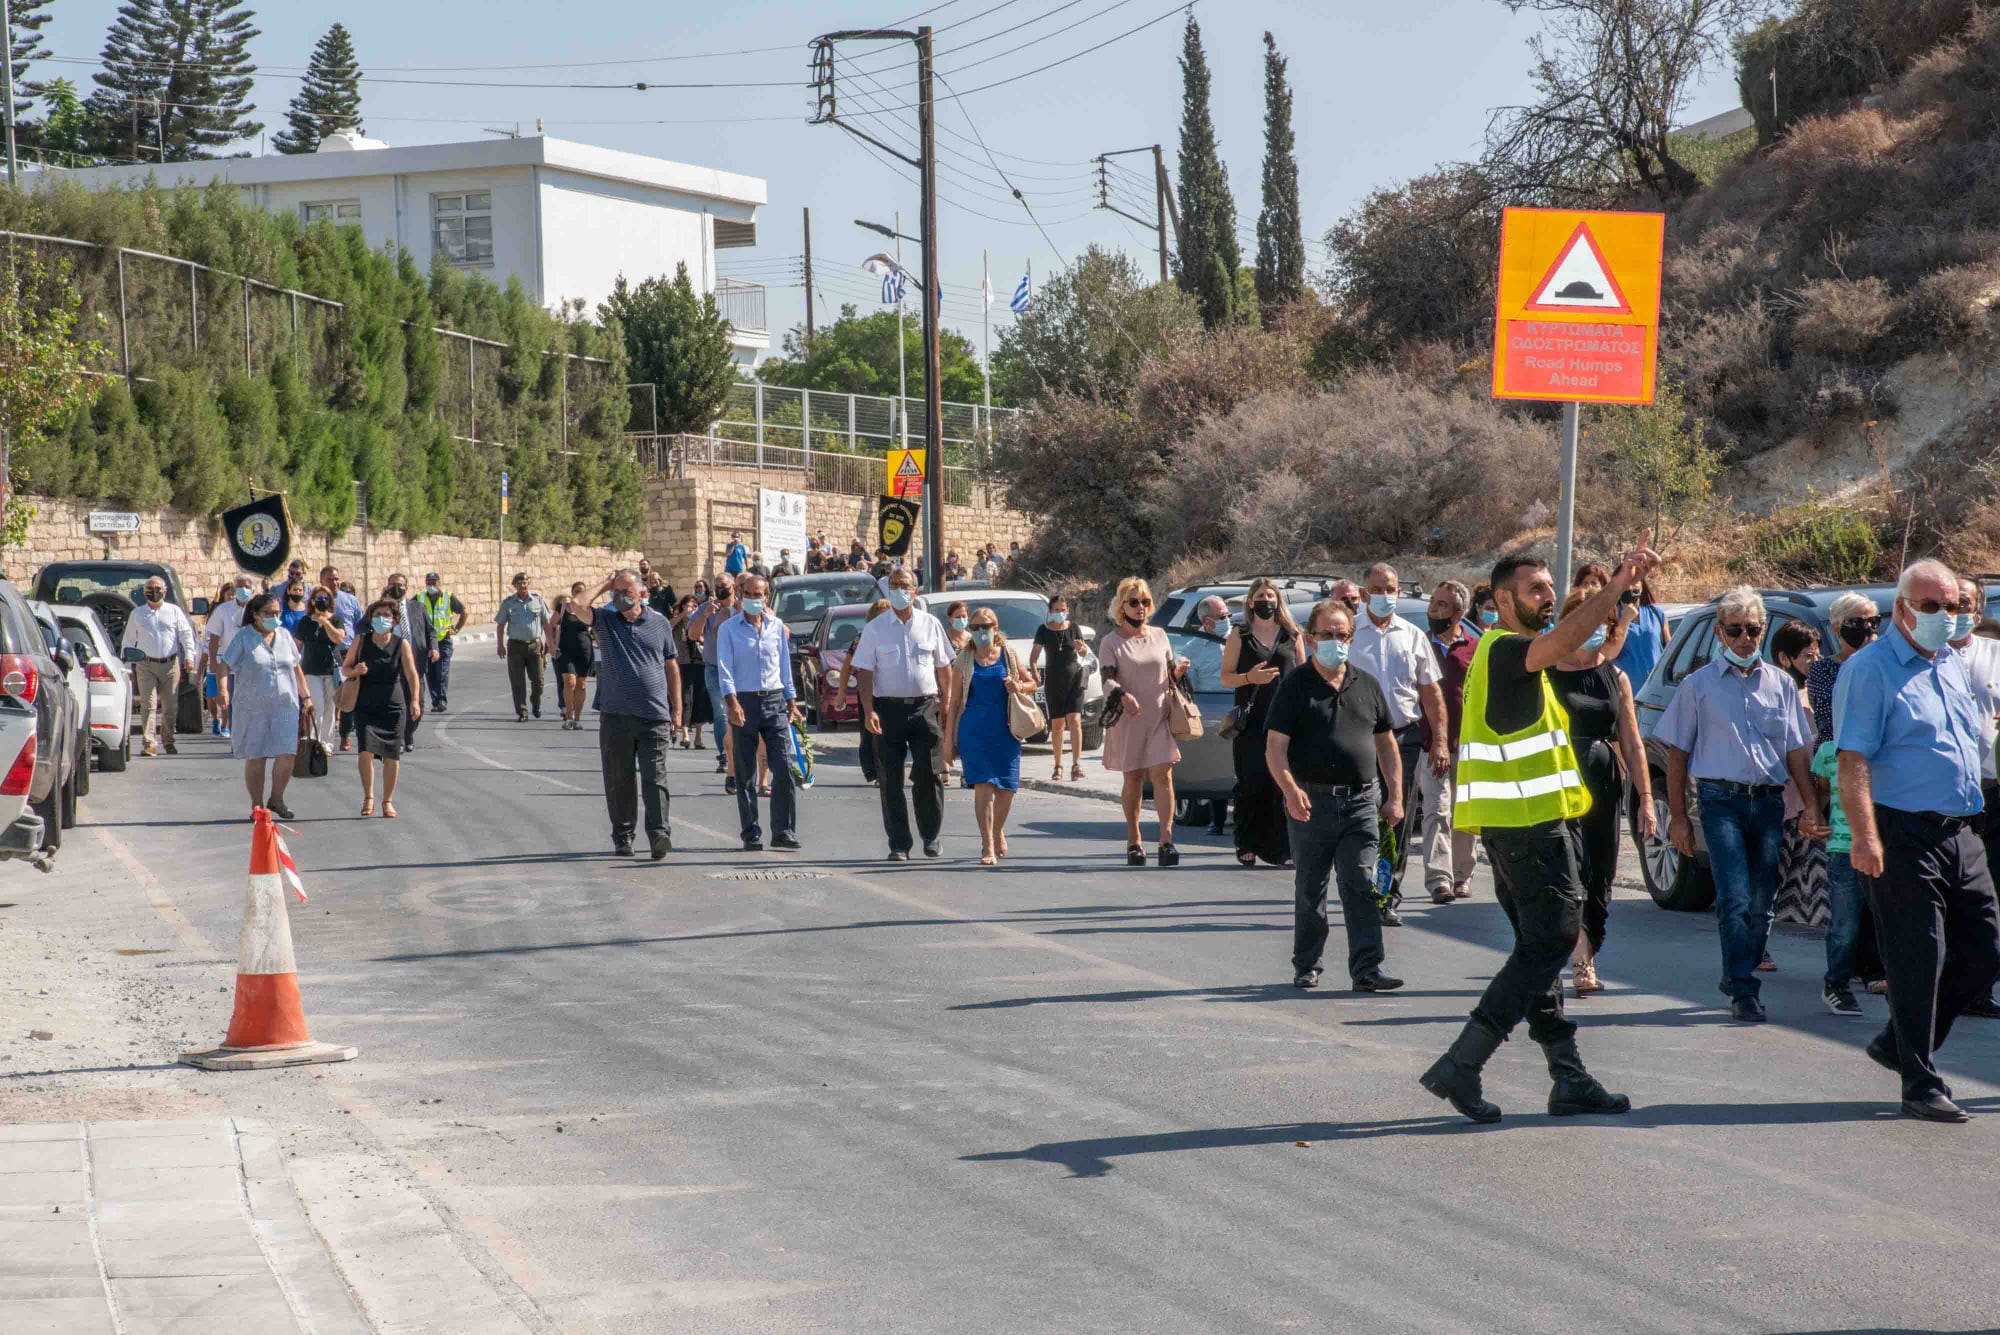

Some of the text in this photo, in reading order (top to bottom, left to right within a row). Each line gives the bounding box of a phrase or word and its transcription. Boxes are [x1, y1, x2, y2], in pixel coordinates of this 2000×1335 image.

[1527, 322, 1624, 337] ΚΥΡΤΩΜΑΤΑ
[1525, 355, 1623, 375] Road Humps
[1549, 372, 1598, 387] Ahead
